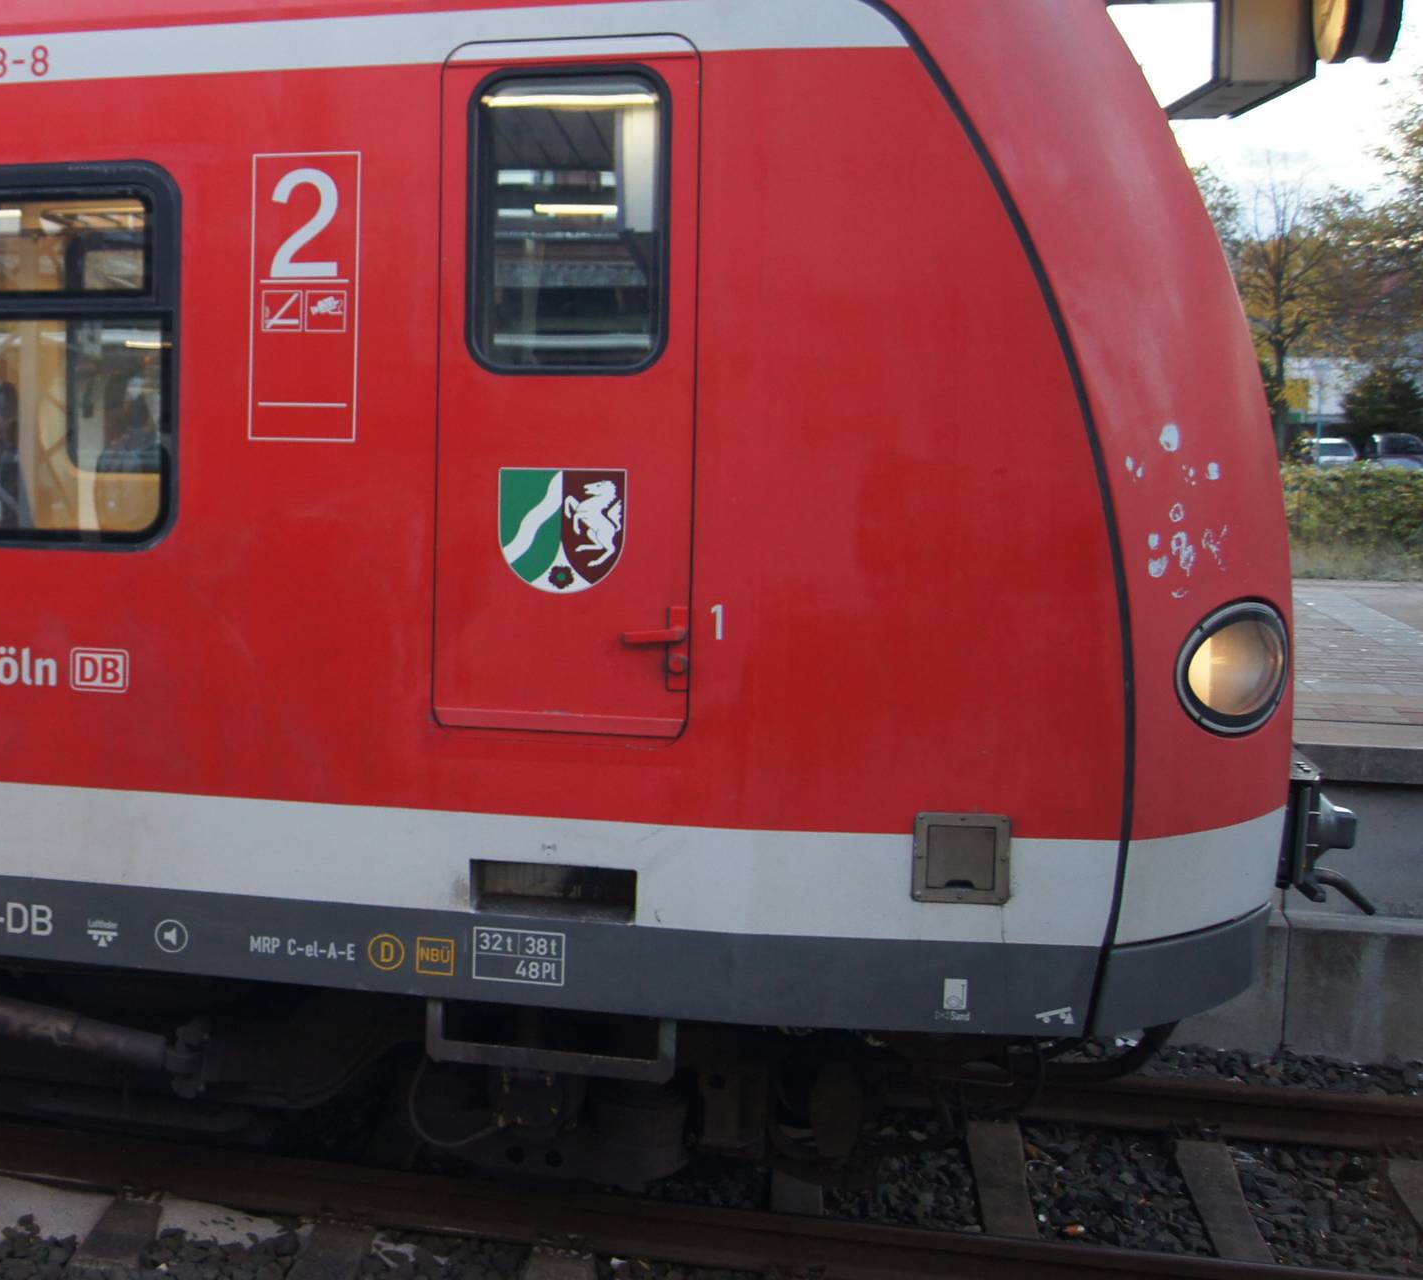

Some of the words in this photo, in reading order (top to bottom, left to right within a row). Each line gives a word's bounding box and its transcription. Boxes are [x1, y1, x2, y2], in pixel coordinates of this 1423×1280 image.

[270, 168, 339, 278] 2
[711, 604, 723, 640] 1
[74, 651, 126, 690] DB
[249, 934, 280, 956] MRP
[287, 938, 356, 962] C-el-A-E
[380, 944, 395, 963] D
[420, 946, 452, 965] NBÜ
